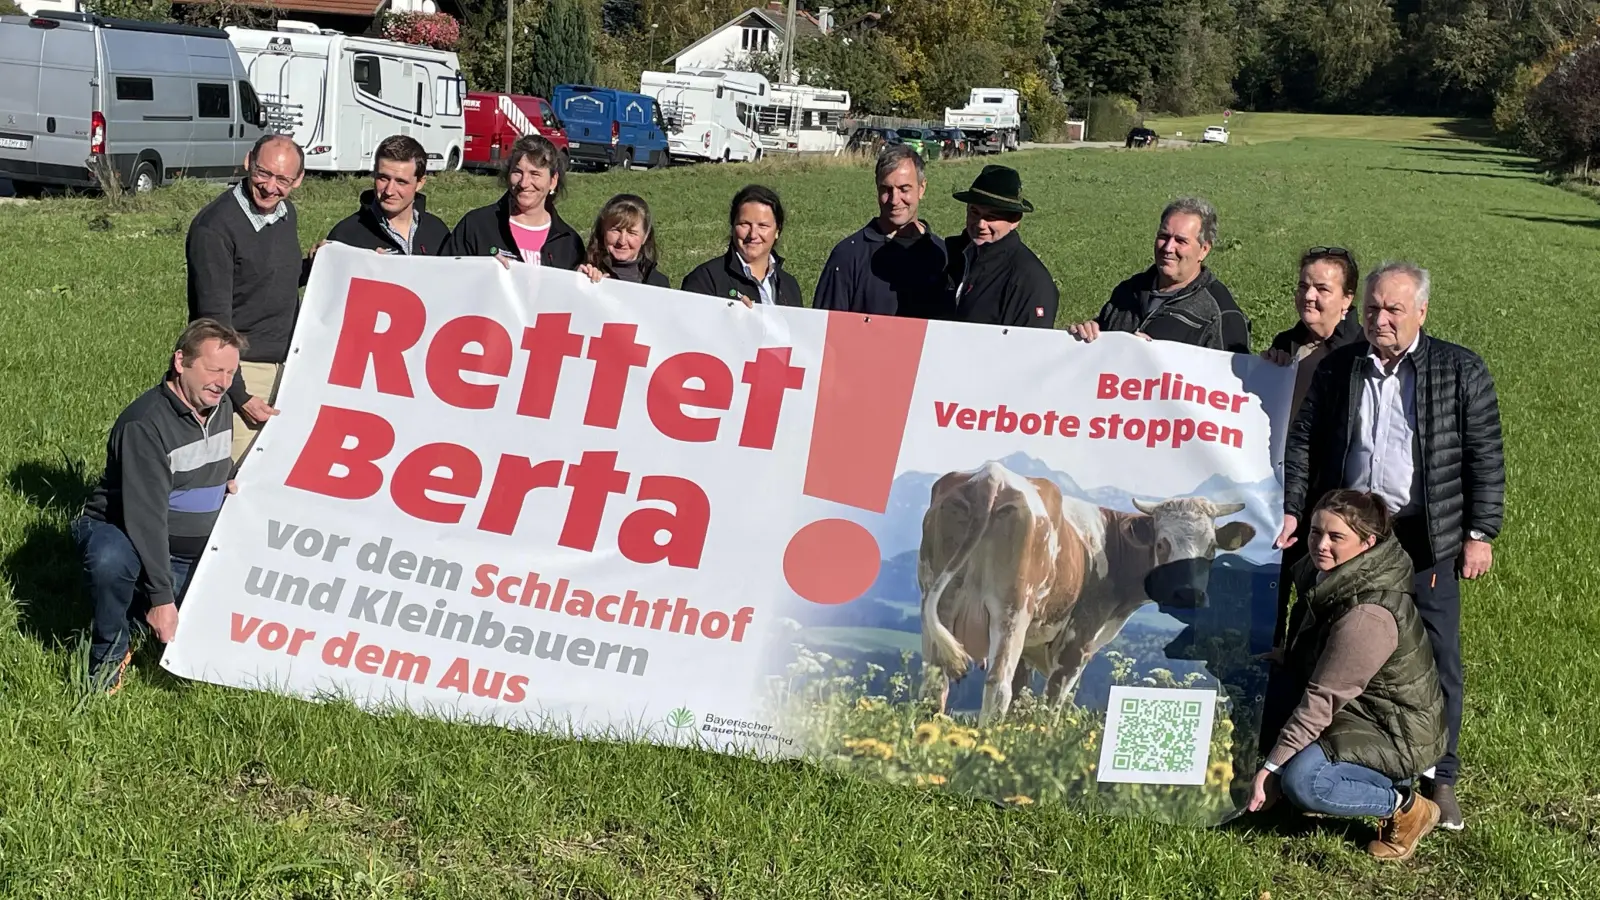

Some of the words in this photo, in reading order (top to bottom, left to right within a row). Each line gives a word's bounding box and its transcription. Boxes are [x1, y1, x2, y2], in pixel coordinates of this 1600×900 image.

[329, 278, 804, 449] Rettet
[1098, 373, 1248, 412] Berliner
[936, 402, 1079, 436] Verbote
[1090, 415, 1243, 448] stoppen
[286, 405, 709, 568] Berta
[245, 566, 346, 613] und
[348, 586, 648, 676] Kleinbauern
[267, 519, 350, 563] vor
[357, 537, 462, 591] dem
[472, 566, 754, 641] Schlachthof
[230, 612, 314, 654] vor
[319, 632, 430, 685] dem
[438, 658, 529, 703] Aus
[705, 712, 773, 732] Bayerischer
